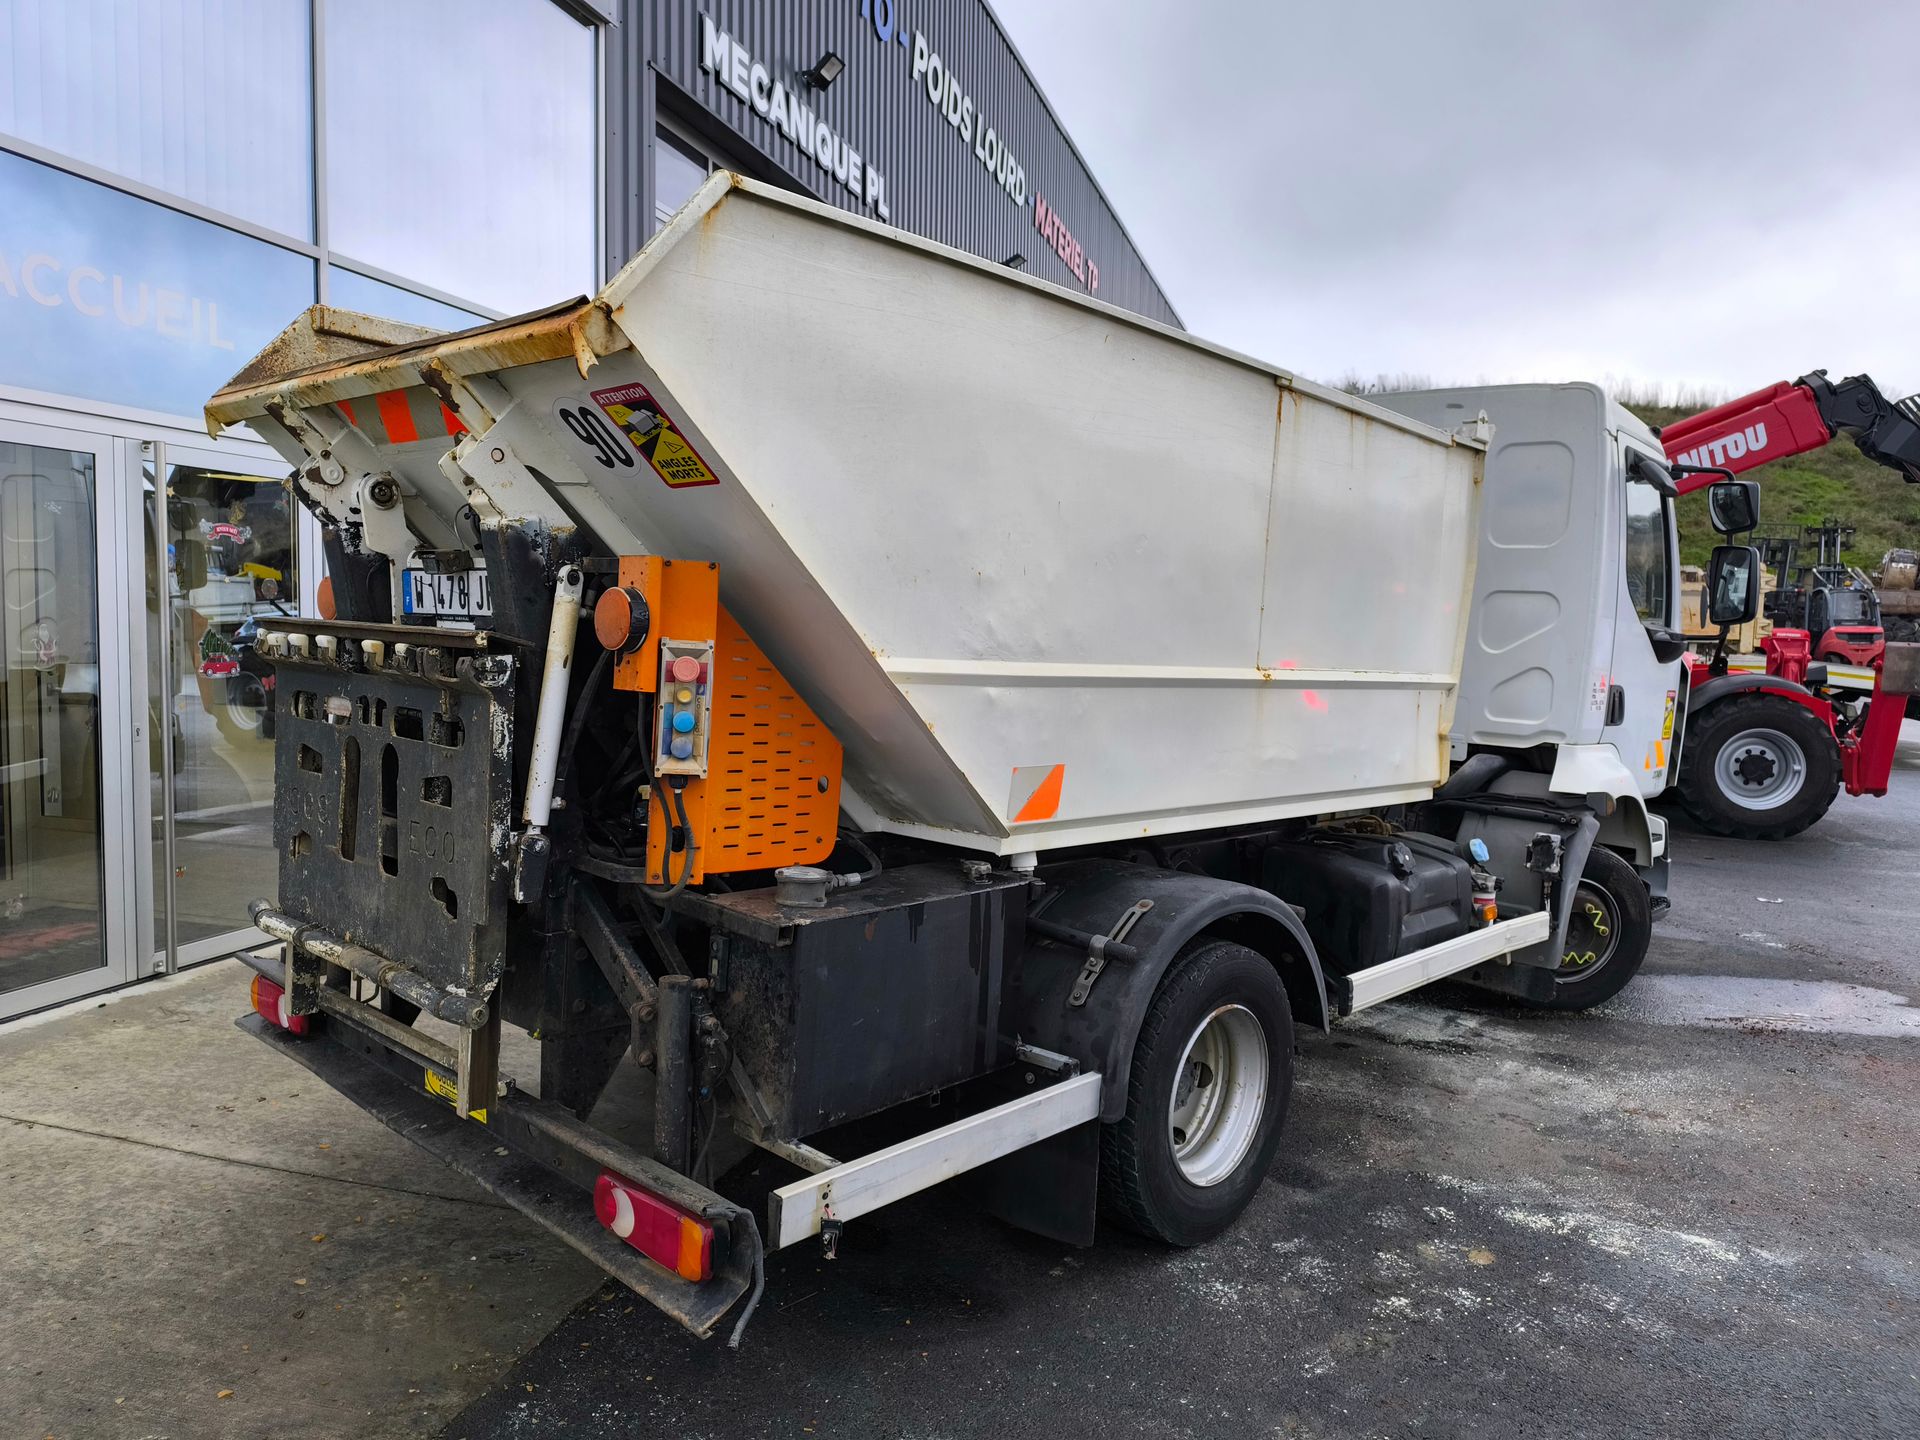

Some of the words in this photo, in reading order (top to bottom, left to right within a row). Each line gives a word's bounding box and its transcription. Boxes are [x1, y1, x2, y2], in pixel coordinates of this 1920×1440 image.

[703, 15, 863, 200] MECANIQUE
[866, 163, 890, 220] PL
[861, 0, 894, 42] O
[912, 29, 974, 143] POIDS
[974, 112, 1026, 206] LOURD
[1034, 190, 1084, 284] MATERIEL
[1085, 258, 1099, 295] TP
[594, 386, 647, 404] ATTENTION
[558, 406, 635, 469] 90
[1666, 422, 1768, 478] NITOU
[657, 456, 698, 470] ANGLES
[666, 467, 705, 480] MORTS
[437, 575, 467, 610] 478
